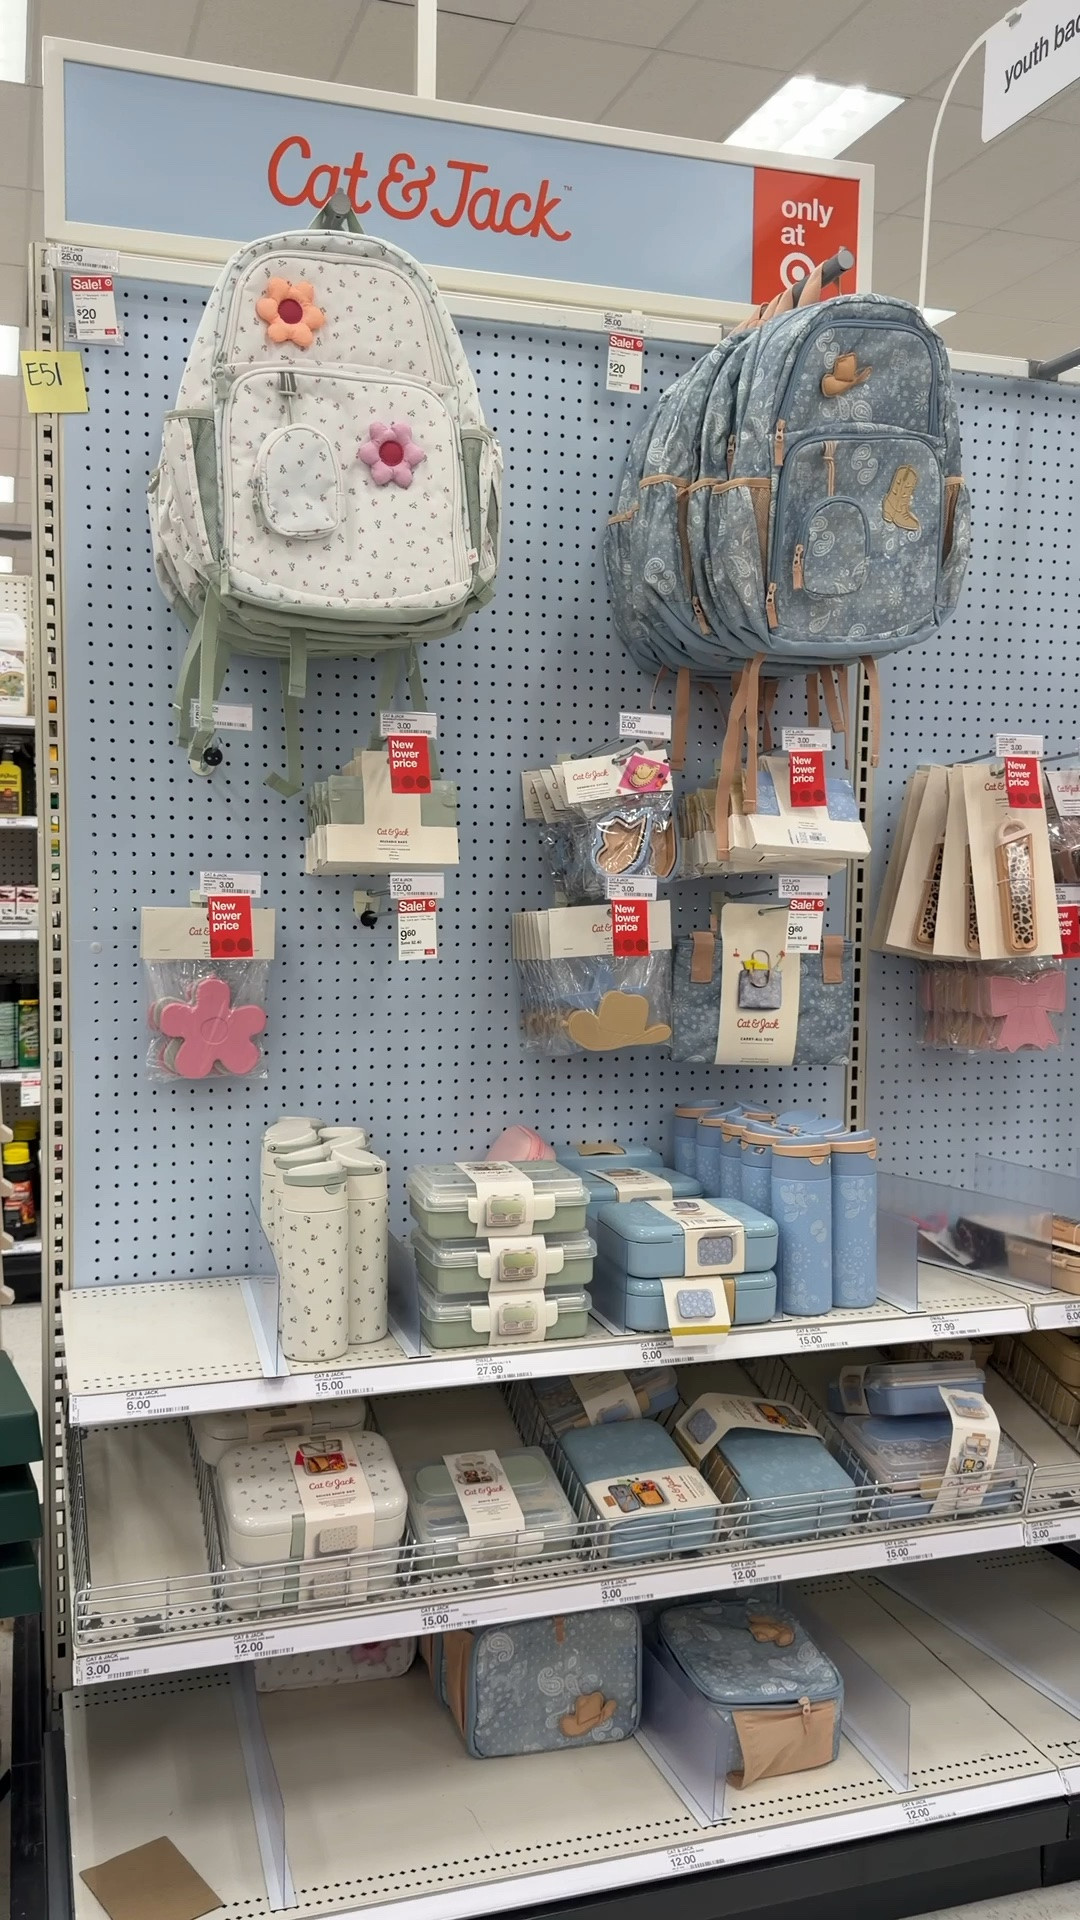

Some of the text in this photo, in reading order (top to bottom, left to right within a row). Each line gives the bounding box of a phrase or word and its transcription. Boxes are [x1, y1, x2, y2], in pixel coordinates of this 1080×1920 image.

[1004, 36, 1049, 93] youth
[268, 136, 572, 241] Cat & Jack
[781, 198, 834, 229] only
[781, 224, 806, 247] at
[61, 253, 83, 262] 25.00
[72, 279, 102, 290] Sale!
[76, 308, 97, 320] $20
[604, 318, 622, 327] 25.00
[610, 336, 634, 349] Sale!
[609, 363, 625, 374] $20
[26, 362, 62, 386] E51
[621, 721, 636, 729] 5.00
[391, 740, 414, 749] New
[392, 750, 419, 758] lower
[393, 759, 417, 769] price
[792, 757, 812, 765] New
[1007, 761, 1026, 770] New
[792, 765, 816, 774] lower
[1008, 770, 1030, 778] lower
[573, 773, 585, 781] Cat
[592, 769, 609, 781] Jack
[793, 774, 814, 784] price
[984, 783, 1004, 791] Cat &
[1008, 779, 1029, 787] price
[377, 827, 409, 838] Cat & Jack
[212, 901, 236, 910] New
[399, 901, 426, 911] Sale!
[615, 904, 635, 913] New
[790, 900, 815, 910] Sale!
[212, 912, 242, 921] lower
[615, 914, 640, 922] lower
[189, 927, 202, 935] Cat
[213, 921, 239, 932] price
[592, 924, 604, 933] Cat
[616, 923, 638, 933] price
[737, 1018, 779, 1033] Cat & Jack
[932, 1323, 955, 1332] 27.99
[799, 1335, 822, 1344] 15.00
[642, 1350, 662, 1360] 6.00
[476, 1365, 503, 1375] 27.99
[315, 1380, 343, 1391] 15.00
[126, 1400, 150, 1410] 6.00
[309, 1477, 356, 1490] Cat & Jack
[485, 1485, 506, 1496] Jack
[1032, 1529, 1049, 1539] 3.00
[886, 1547, 909, 1558] 15.00
[733, 1569, 756, 1580] 12.00
[602, 1588, 622, 1599] 3.00
[422, 1614, 449, 1626] 15.00
[235, 1641, 263, 1654] 12.00
[86, 1664, 110, 1676] 3.00
[906, 1808, 930, 1819] 12.00
[670, 1855, 696, 1867] 12.00
